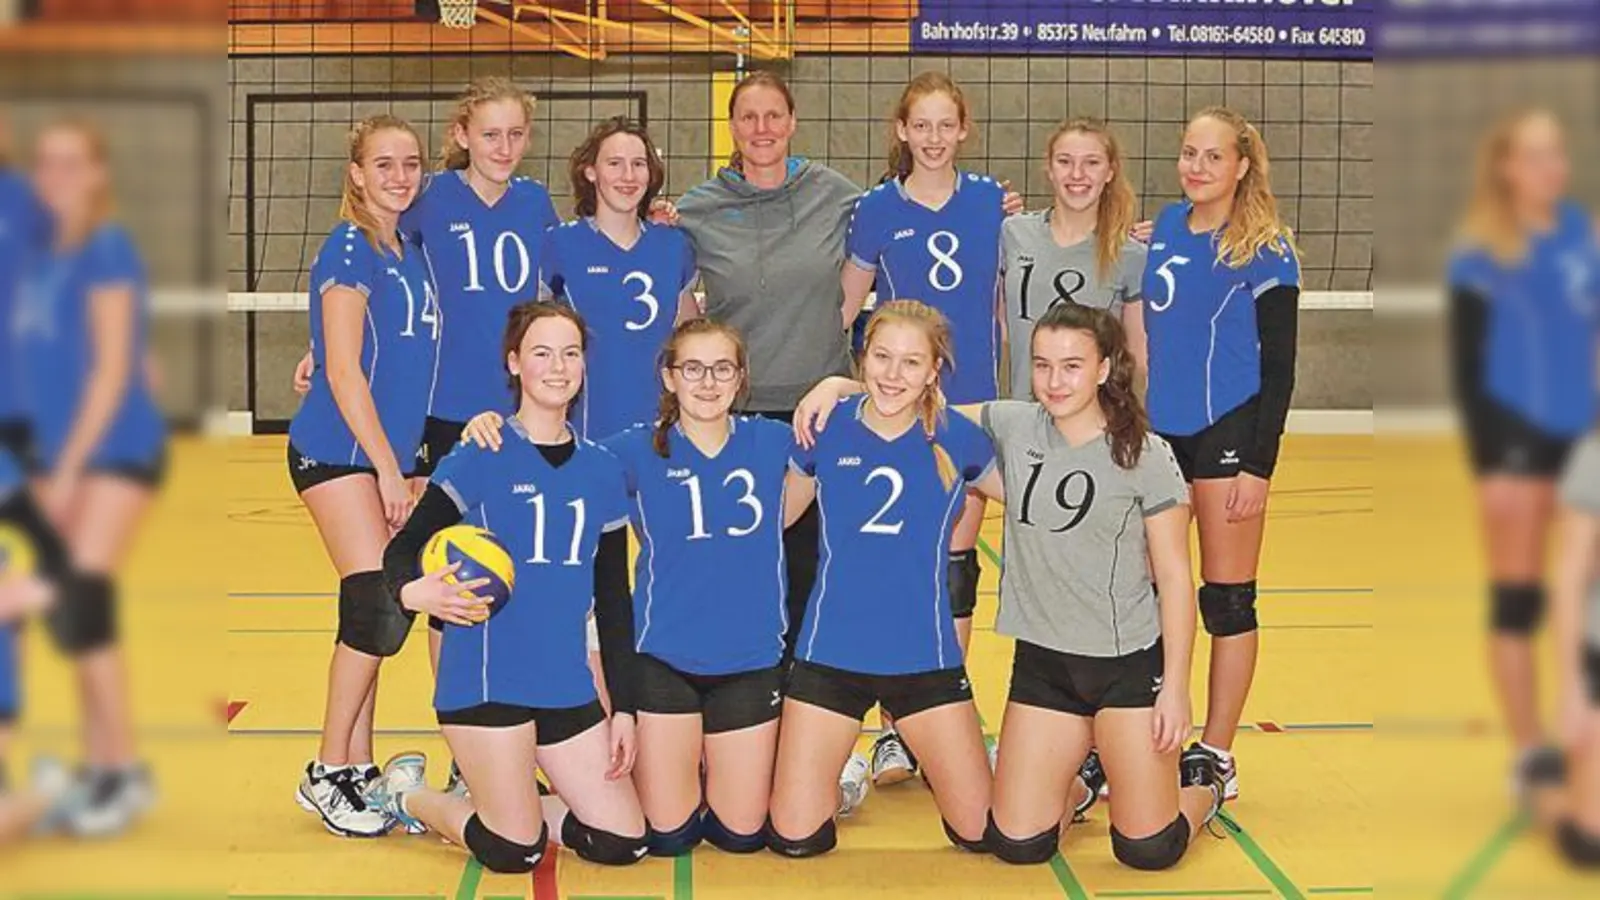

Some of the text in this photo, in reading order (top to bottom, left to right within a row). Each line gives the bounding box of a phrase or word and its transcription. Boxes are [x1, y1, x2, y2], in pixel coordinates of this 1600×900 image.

[1037, 23, 1078, 41] 85375
[1291, 27, 1315, 44] Fax
[458, 230, 529, 293] 10
[927, 230, 963, 291] 8
[1150, 255, 1191, 311] 5
[398, 276, 438, 340] 14
[622, 271, 659, 330] 3
[1019, 264, 1085, 319] 18
[512, 484, 536, 494] JAKO
[836, 456, 862, 466] JAKO
[679, 468, 763, 540] 13
[859, 466, 904, 535] 2
[1017, 462, 1096, 533] 19
[525, 493, 585, 566] 11
